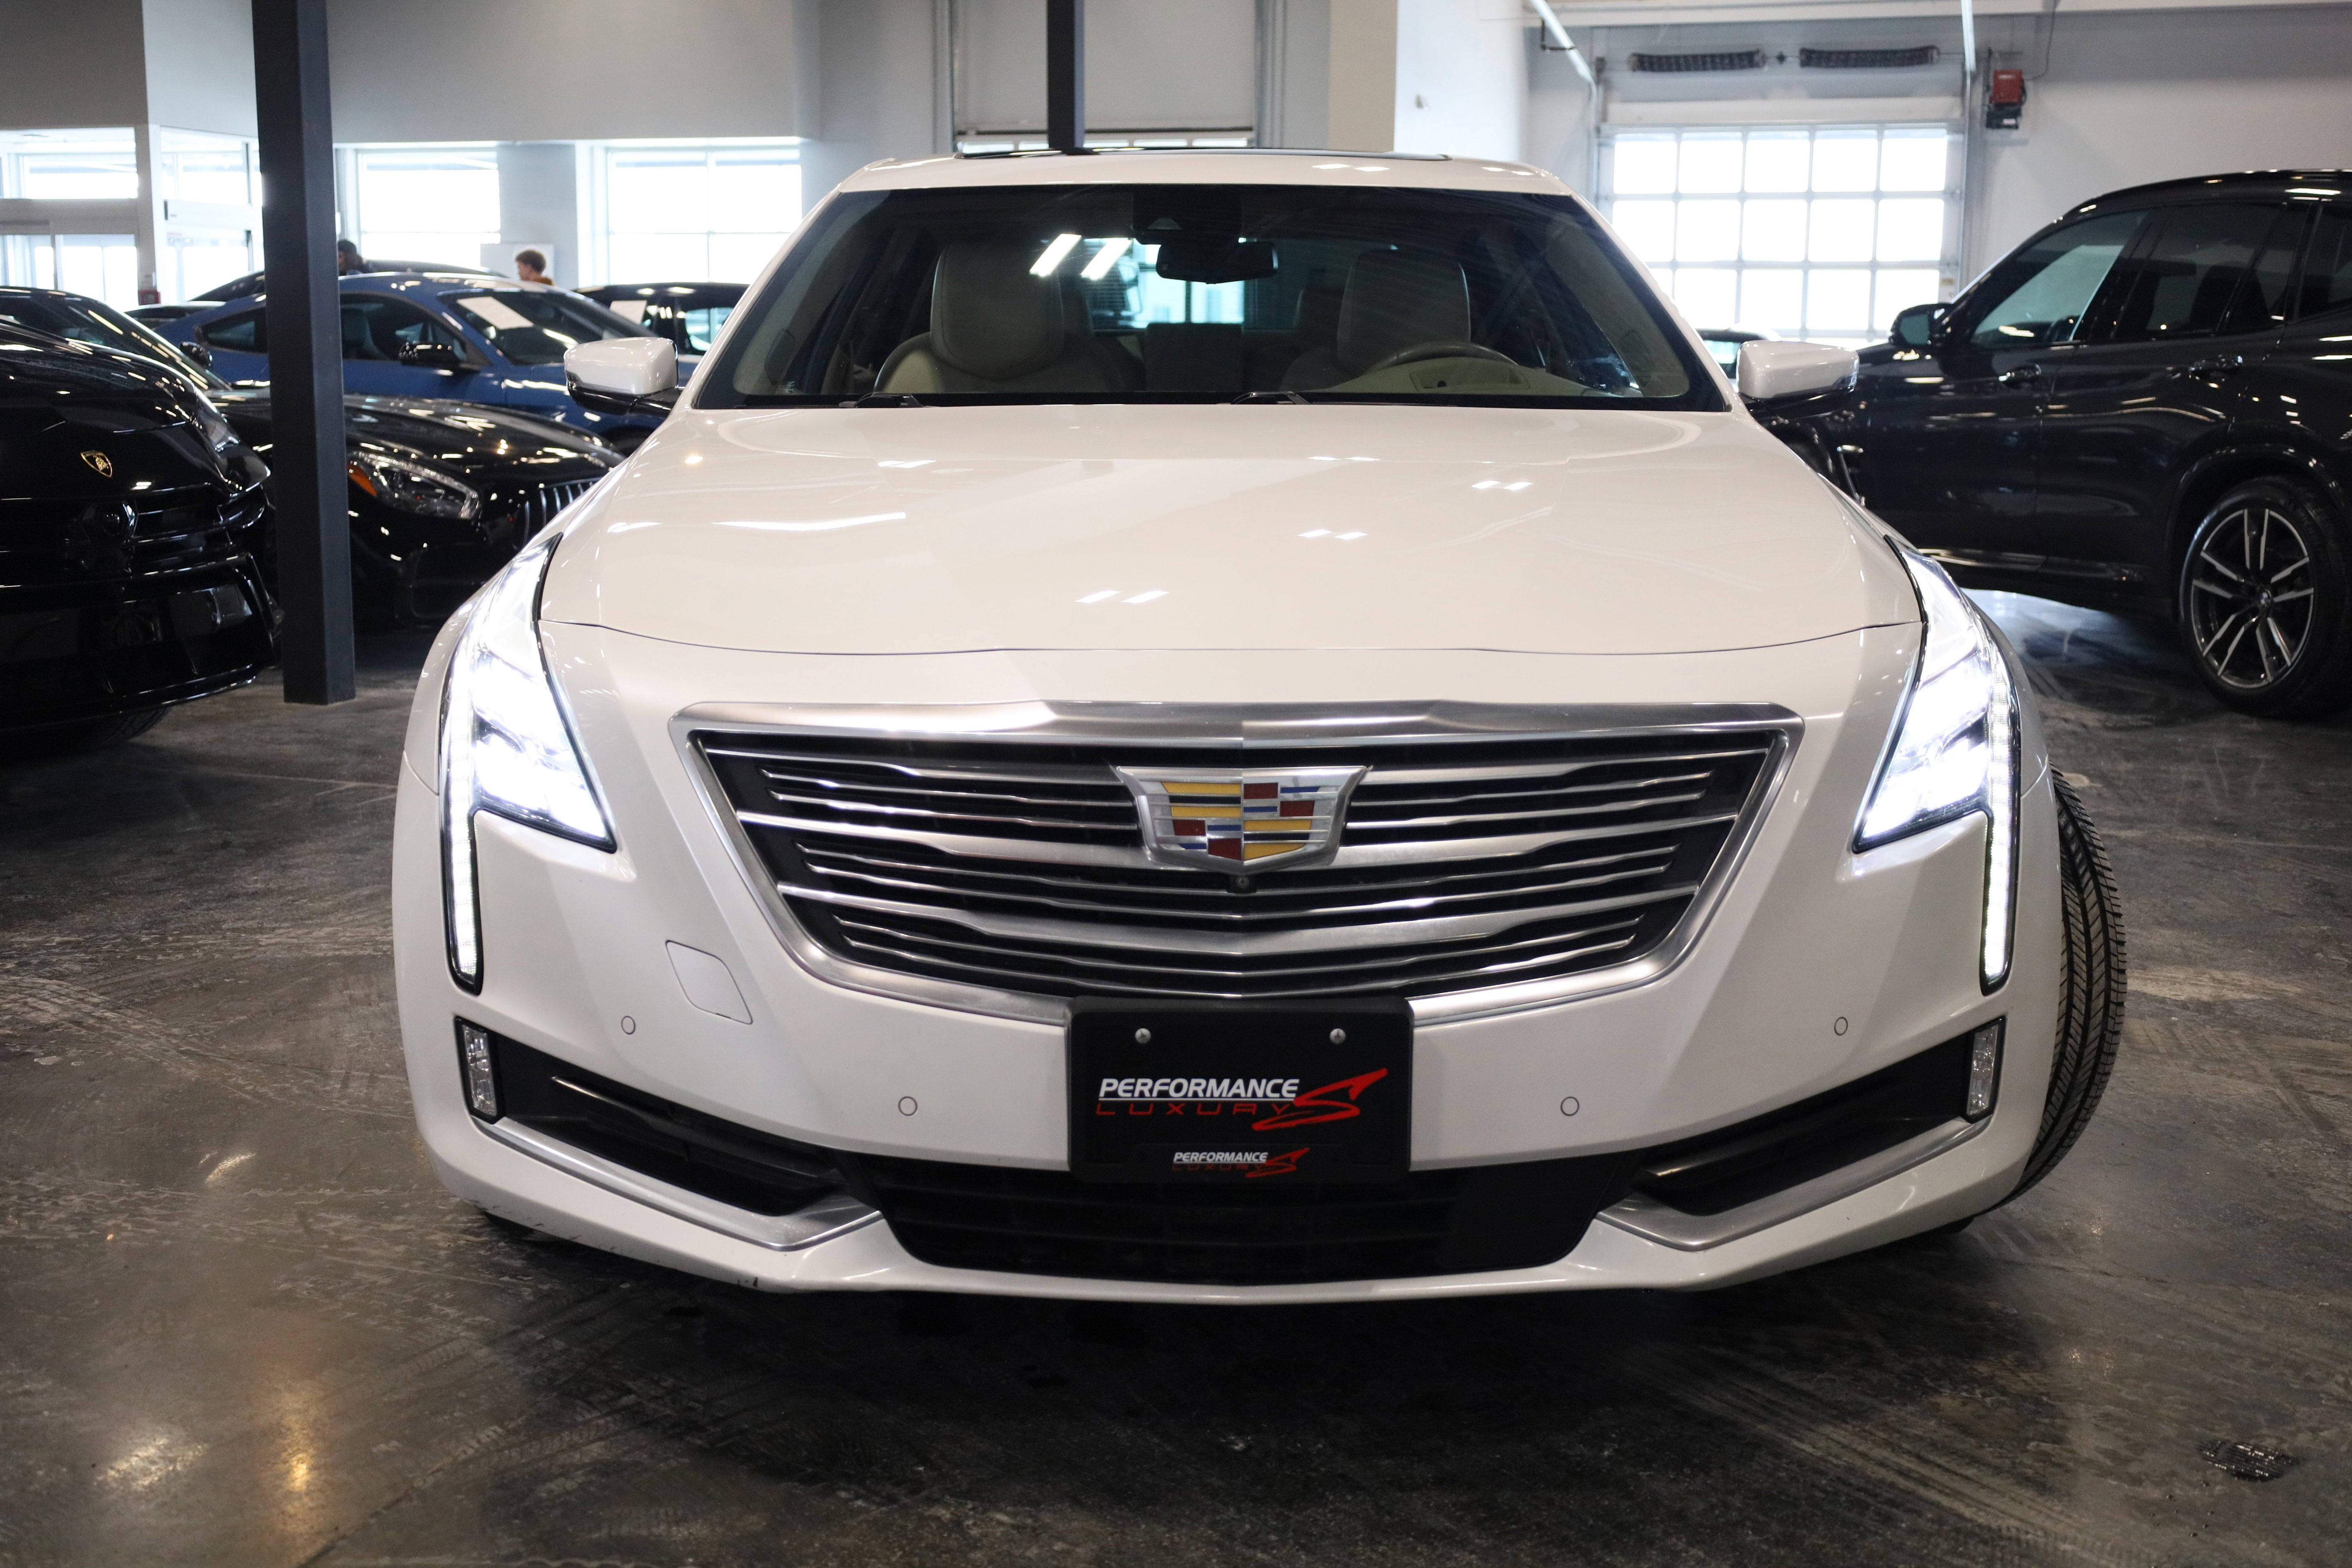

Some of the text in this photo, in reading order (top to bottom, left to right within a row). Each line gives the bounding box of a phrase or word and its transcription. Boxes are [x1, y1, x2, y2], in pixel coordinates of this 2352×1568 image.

[1099, 1078, 1300, 1098] PERFORMANCE
[1096, 1103, 1290, 1115] LUXURY
[1173, 1152, 1268, 1162] PERFORMANCE
